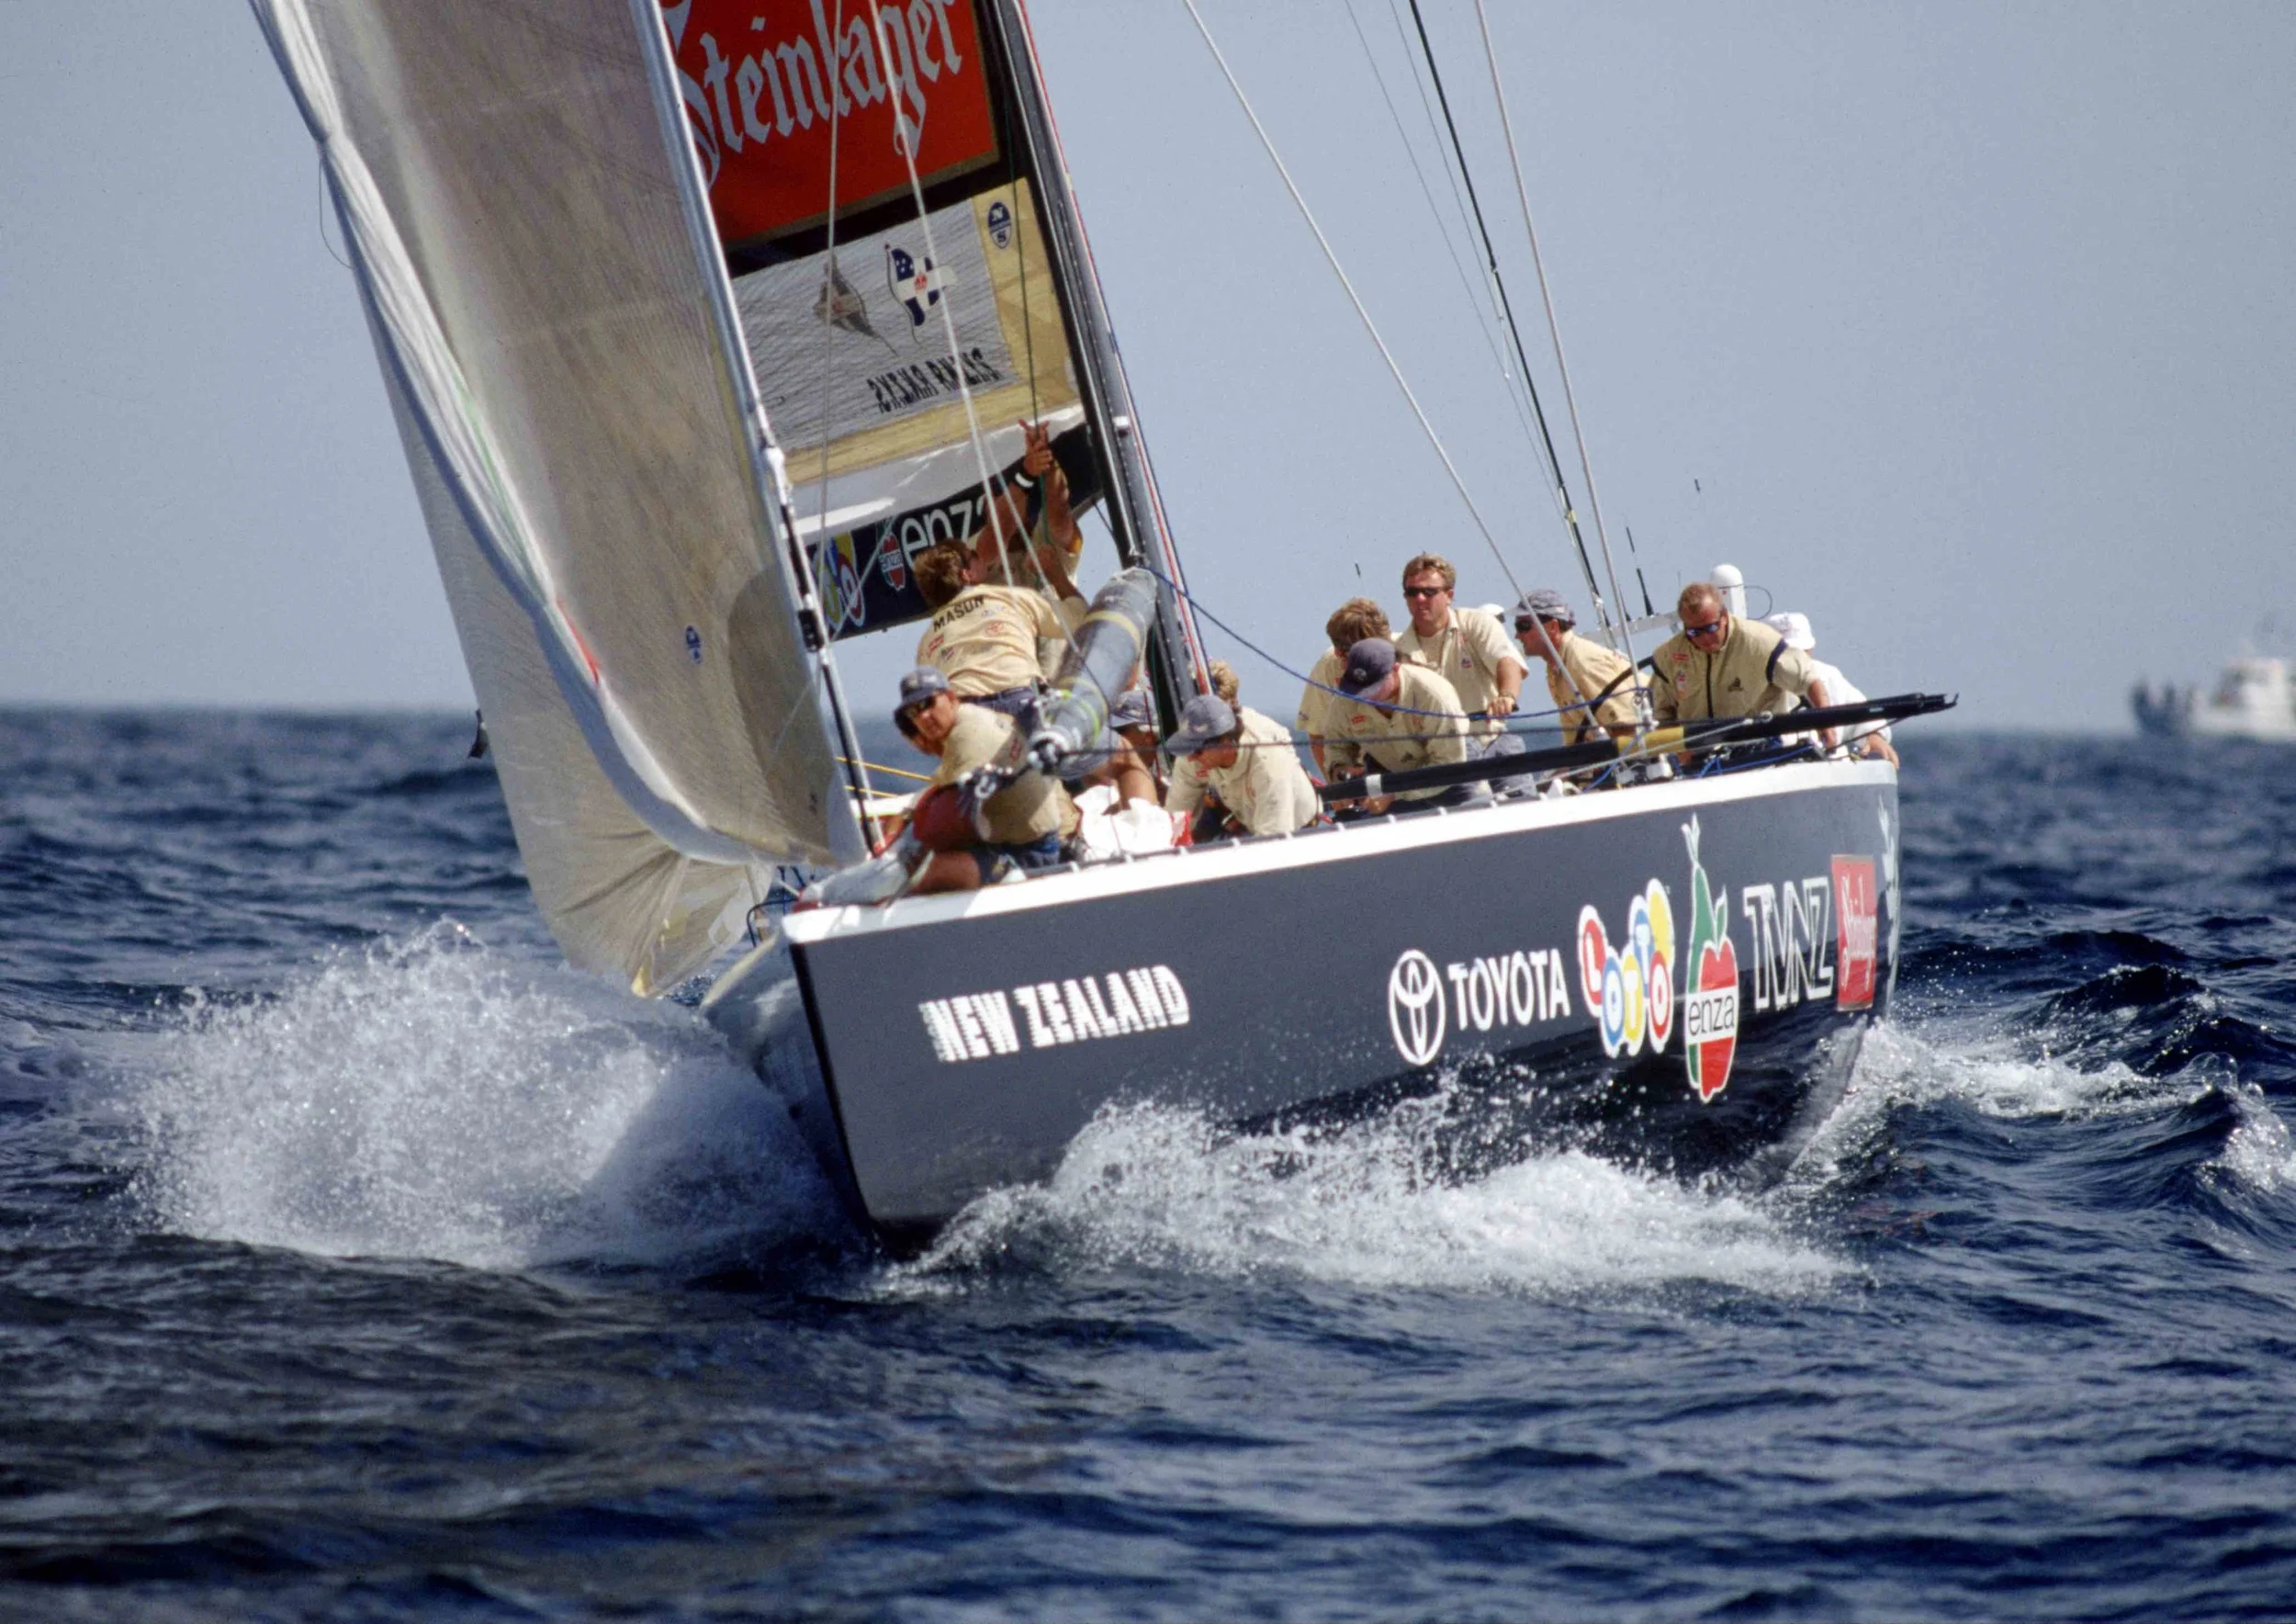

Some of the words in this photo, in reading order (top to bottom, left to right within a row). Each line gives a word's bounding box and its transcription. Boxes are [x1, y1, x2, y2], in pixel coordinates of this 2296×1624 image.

[901, 495, 985, 571] enz
[918, 990, 1020, 1062] NEW
[1013, 964, 1190, 1048] ZEALAND
[1446, 948, 1572, 1032] TOYOTA
[1687, 992, 1736, 1037] enza
